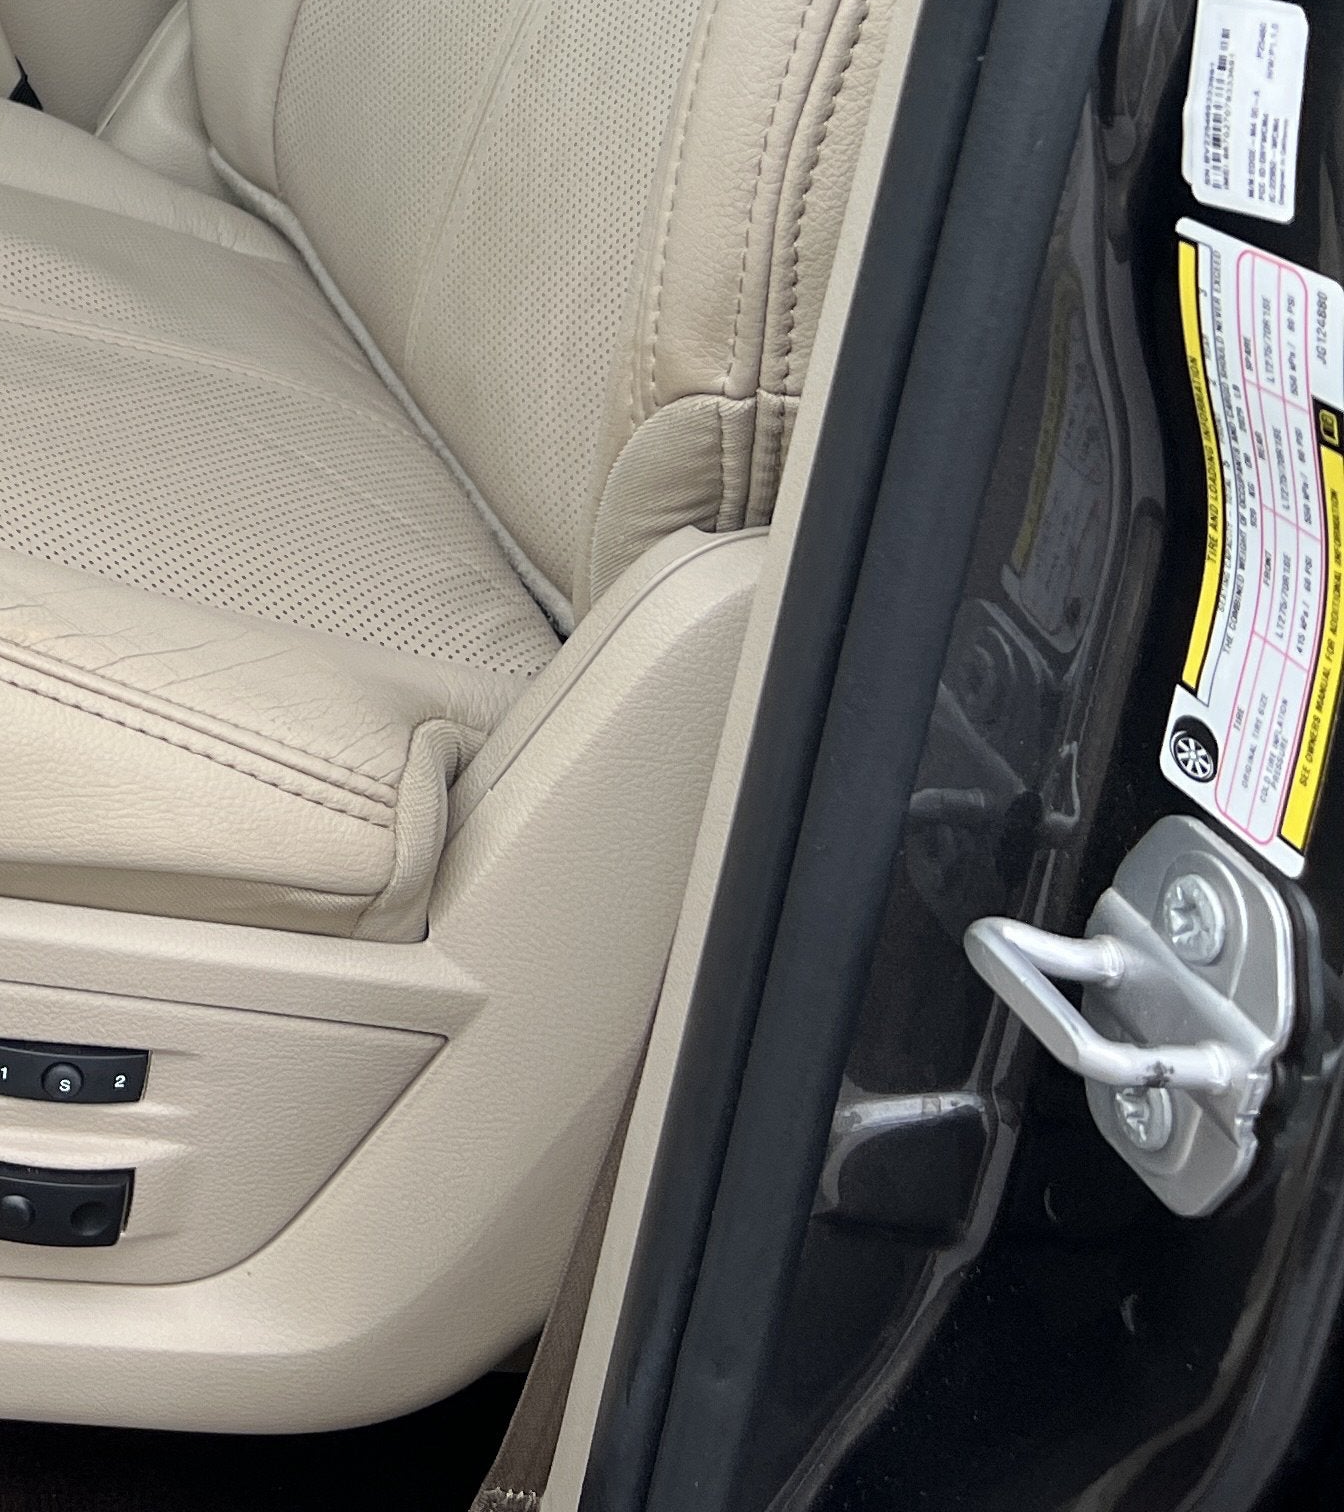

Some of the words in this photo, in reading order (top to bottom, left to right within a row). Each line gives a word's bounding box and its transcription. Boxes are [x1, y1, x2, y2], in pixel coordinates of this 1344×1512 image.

[1212, 250, 1221, 293] EXCEED
[1212, 297, 1223, 333] NEVER
[1215, 337, 1228, 379] SHOULD
[1243, 336, 1253, 371] SPARE
[1189, 355, 1211, 442] INFORMATION
[1228, 421, 1239, 444] AND
[1254, 431, 1265, 460] REAR
[1205, 445, 1217, 501] LOADING
[1207, 504, 1218, 532] AND
[1330, 488, 1341, 566] INFORMATION
[1207, 534, 1217, 564] TIRE
[1263, 550, 1272, 586] FRONT
[1229, 574, 1244, 630] COMBINED
[1329, 570, 1342, 635] ADDITIONAL
[1324, 639, 1335, 662] FOR
[1315, 667, 1331, 712] MANUAL
[1232, 705, 1244, 731] TIRE
[1304, 714, 1321, 763] OWNERS
[1299, 766, 1310, 786] SEE
[0, 1065, 9, 1081] 1
[58, 1078, 72, 1093] S
[113, 1073, 127, 1089] 2
